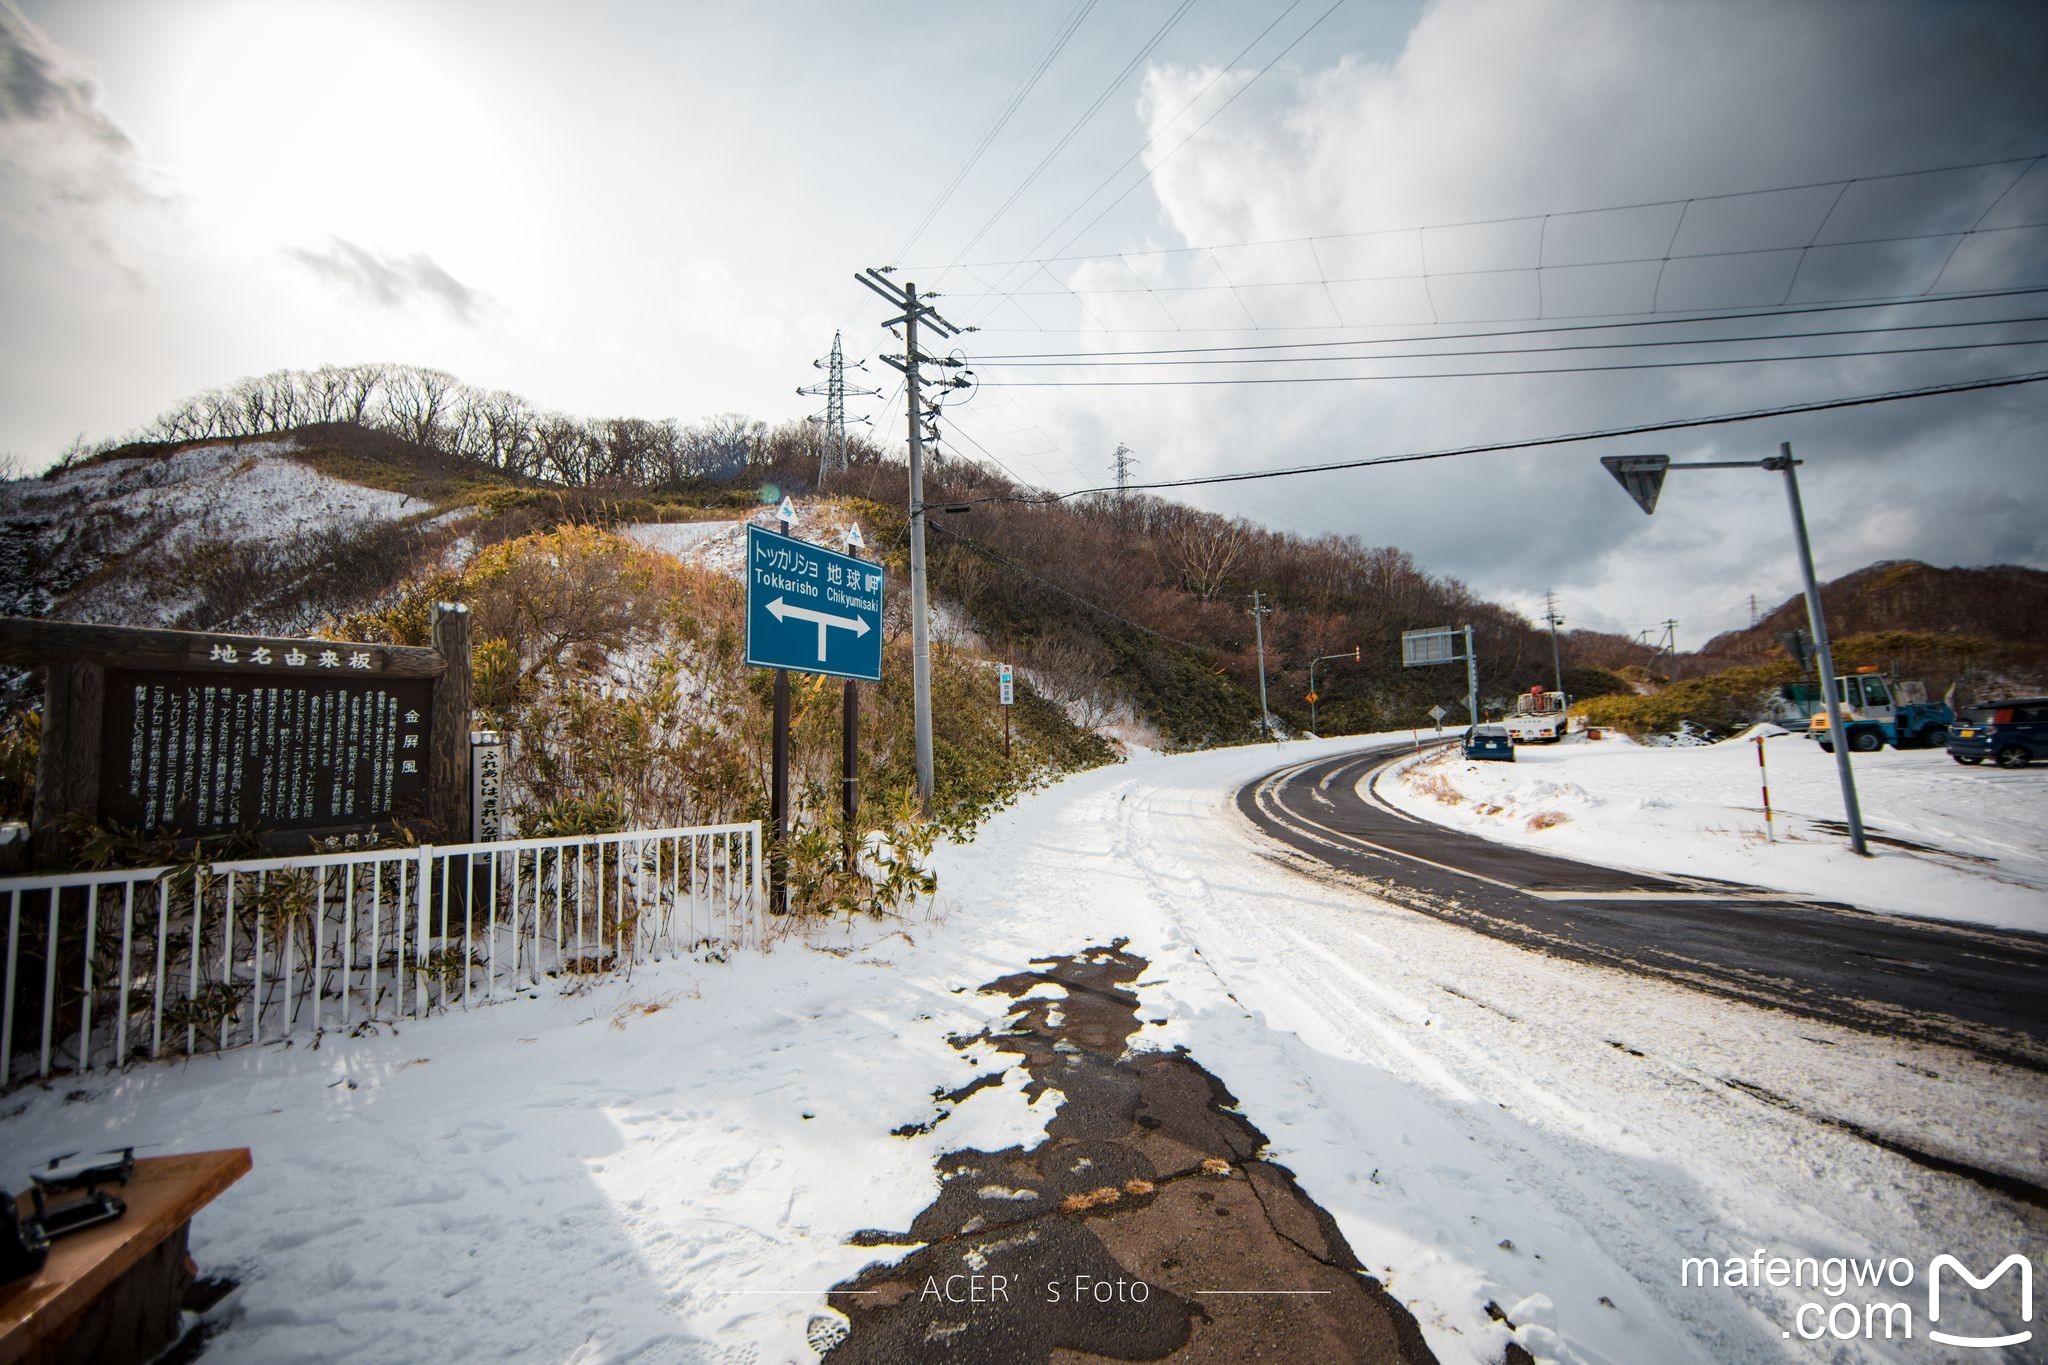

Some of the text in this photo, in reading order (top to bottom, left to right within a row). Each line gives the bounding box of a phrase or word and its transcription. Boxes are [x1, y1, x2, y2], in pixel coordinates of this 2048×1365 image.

[755, 540, 879, 596] トッカリショ 地球岬
[755, 568, 879, 613] Tokkarisho Chikyumisaki
[209, 643, 373, 671] 地名由来板
[401, 709, 420, 774] 金屏風
